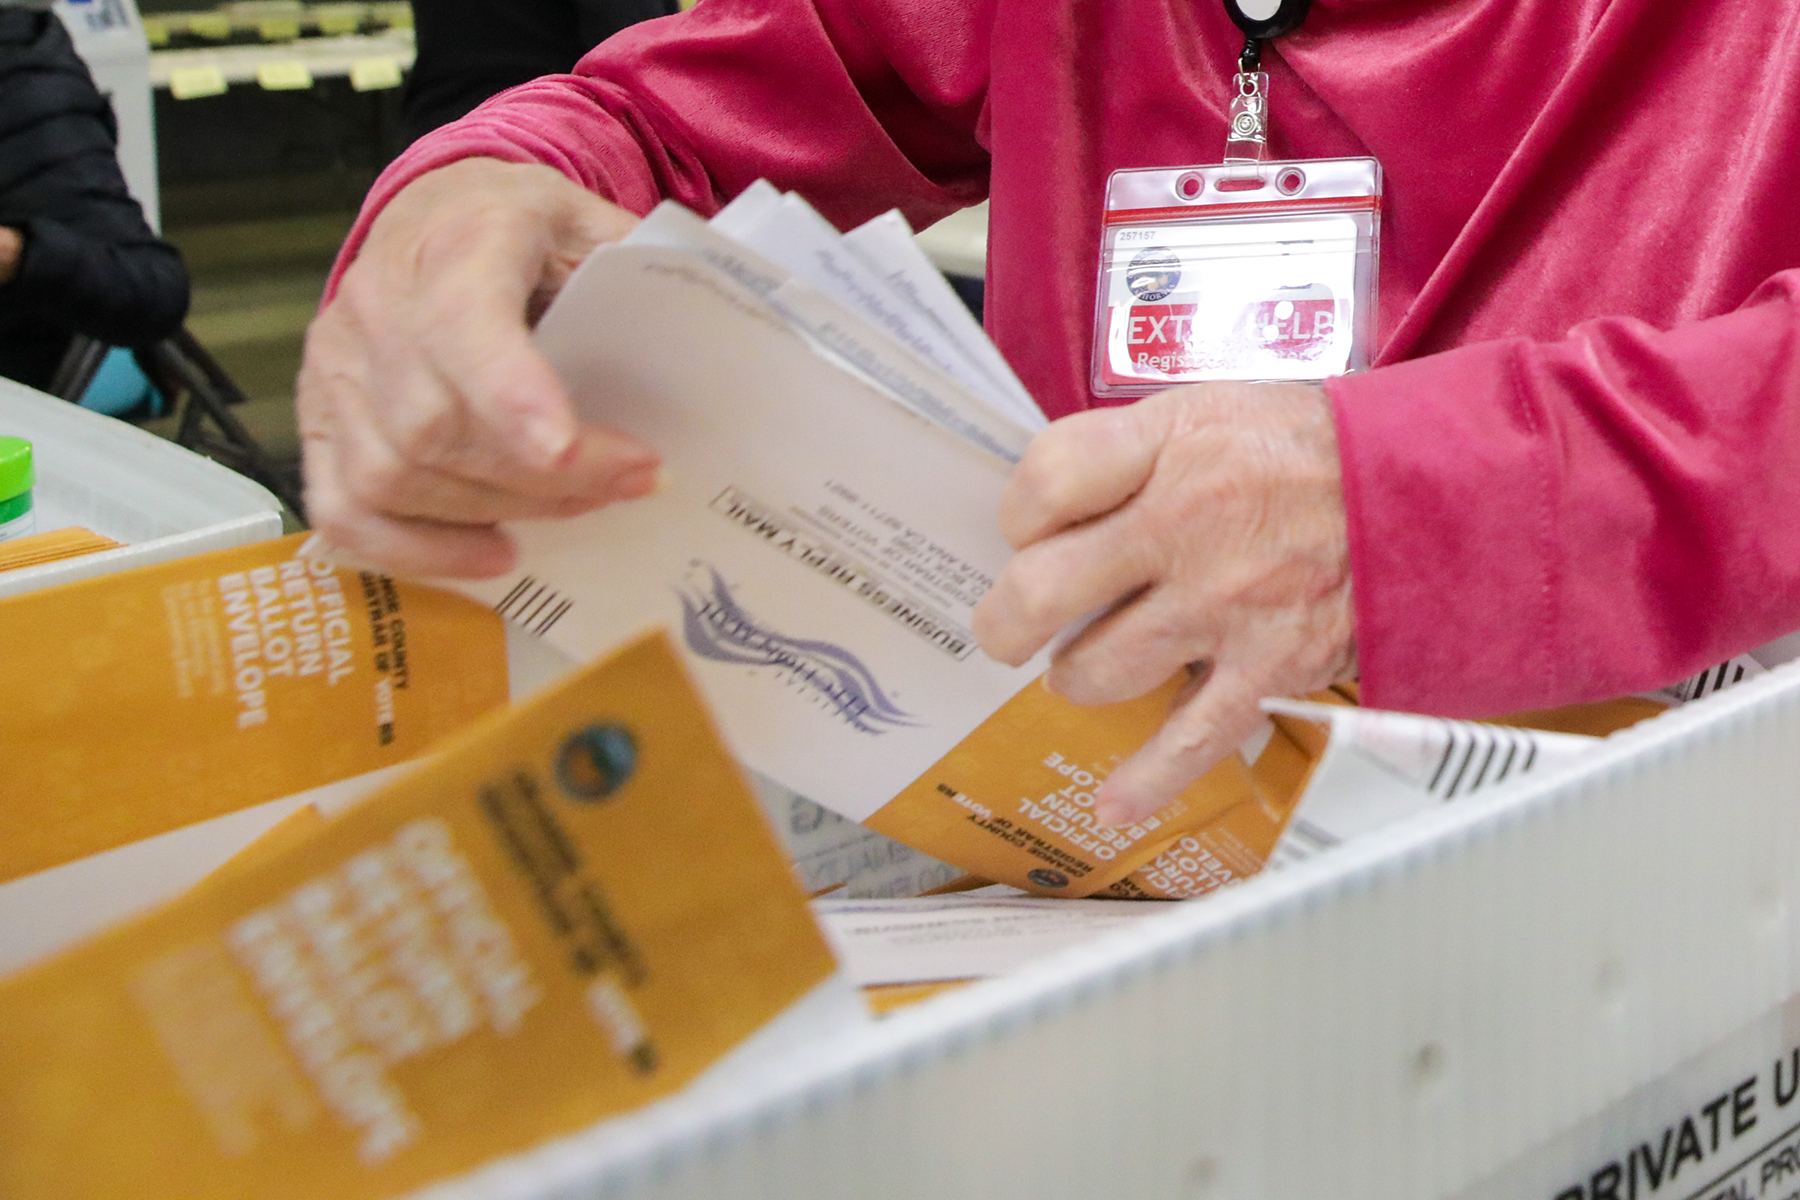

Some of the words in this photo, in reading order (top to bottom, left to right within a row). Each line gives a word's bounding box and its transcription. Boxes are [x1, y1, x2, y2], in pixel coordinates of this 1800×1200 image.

[1119, 230, 1156, 241] 257157
[727, 501, 780, 540] MAIL
[247, 564, 295, 677] BALLOT
[277, 558, 325, 676] RETURN
[308, 558, 357, 685] OFFICIAL
[855, 581, 967, 655] BUSINESS
[216, 571, 269, 729] ENVELOPE
[935, 782, 992, 818] VOTERS
[1041, 750, 1162, 831] ELOPE
[1057, 782, 1147, 841] BOT
[966, 813, 1025, 848] COUNTY
[1014, 827, 1094, 873] REGISTRAR
[1016, 796, 1117, 862] OFFICIAL
[1039, 791, 1133, 850] RETURN
[1155, 852, 1205, 898] TURN
[1163, 848, 1220, 889] LLOT
[1553, 1075, 1757, 1200] RIVATE
